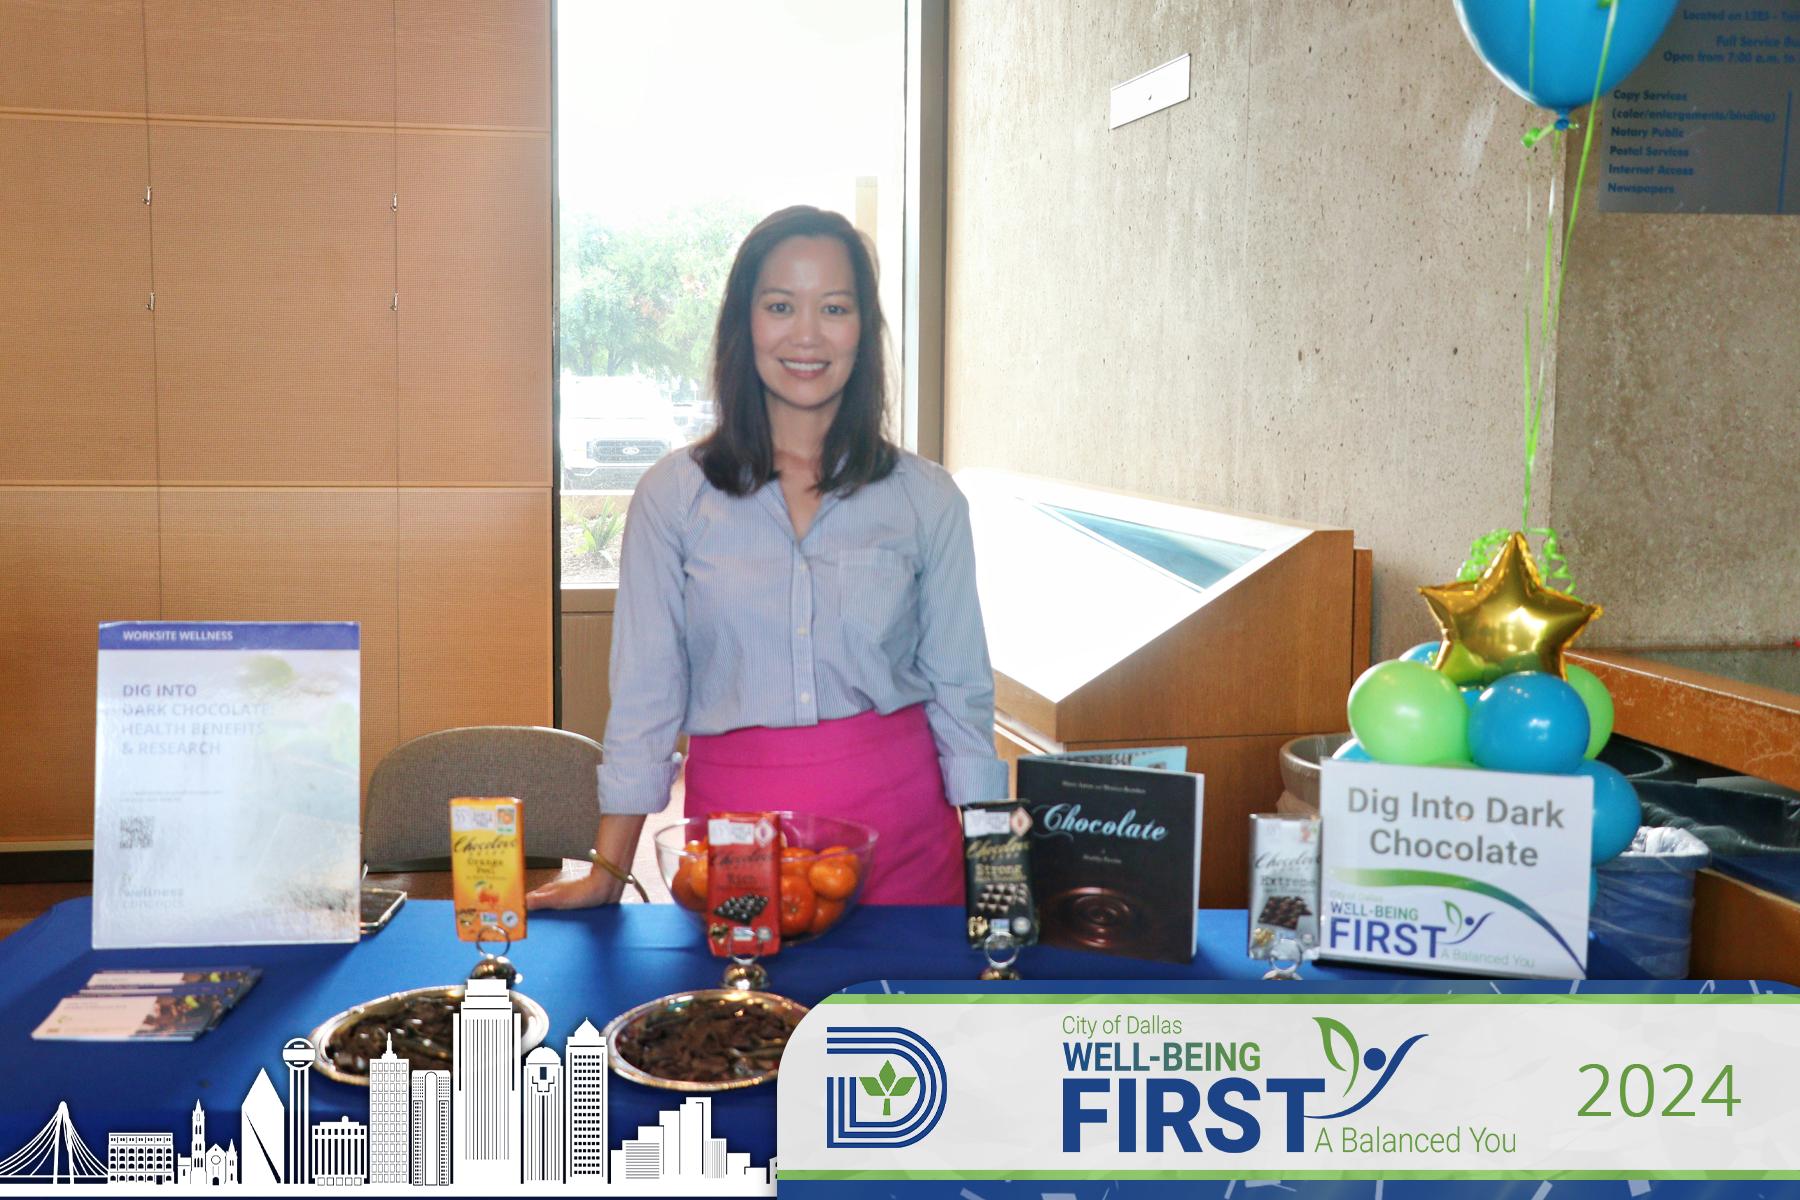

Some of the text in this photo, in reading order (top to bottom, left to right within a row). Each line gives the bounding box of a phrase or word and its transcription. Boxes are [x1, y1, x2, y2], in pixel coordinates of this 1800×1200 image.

[1716, 34, 1737, 47] Full
[1740, 35, 1779, 48] Service
[1664, 50, 1695, 63] Open
[1698, 50, 1724, 63] from
[1613, 89, 1688, 101] Copy Services
[1610, 126, 1684, 139] Notary Public
[1609, 145, 1689, 157] Postal Services
[1608, 164, 1694, 176] Internet Access
[1607, 182, 1675, 195] Newspapers
[122, 630, 233, 642] WORKSITE WELLNESS
[122, 683, 197, 698] DIG INTO
[122, 703, 270, 718] DARK CHOCOLATE
[121, 722, 265, 737] HEALTH BENEFITS
[121, 742, 221, 756] & RESEARCH
[1348, 787, 1565, 829] Dig Into Dark
[1043, 803, 1168, 842] Chocolate
[1369, 829, 1539, 867] Chocolate
[1330, 900, 1419, 922] WELL-BEING
[1329, 916, 1446, 959] FIRST
[1452, 950, 1509, 967] Balanced
[1512, 954, 1535, 968] You
